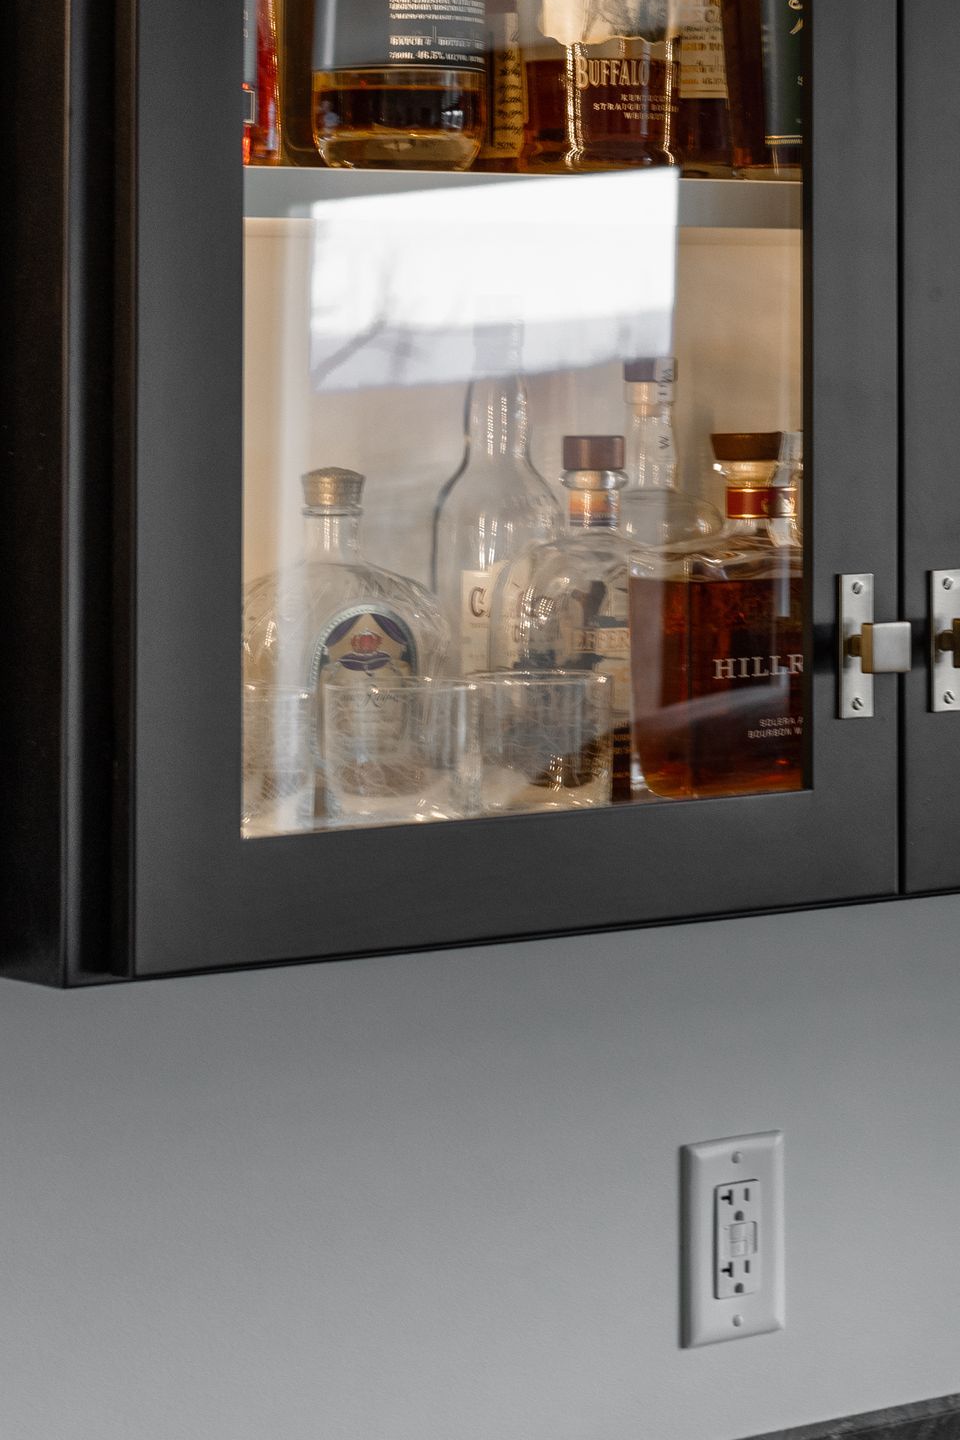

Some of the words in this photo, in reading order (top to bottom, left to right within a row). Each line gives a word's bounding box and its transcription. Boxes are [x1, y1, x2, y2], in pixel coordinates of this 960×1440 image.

[574, 54, 649, 90] BUFFALO
[760, 717, 796, 727] SOLERA
[747, 728, 792, 739] BOURBON
